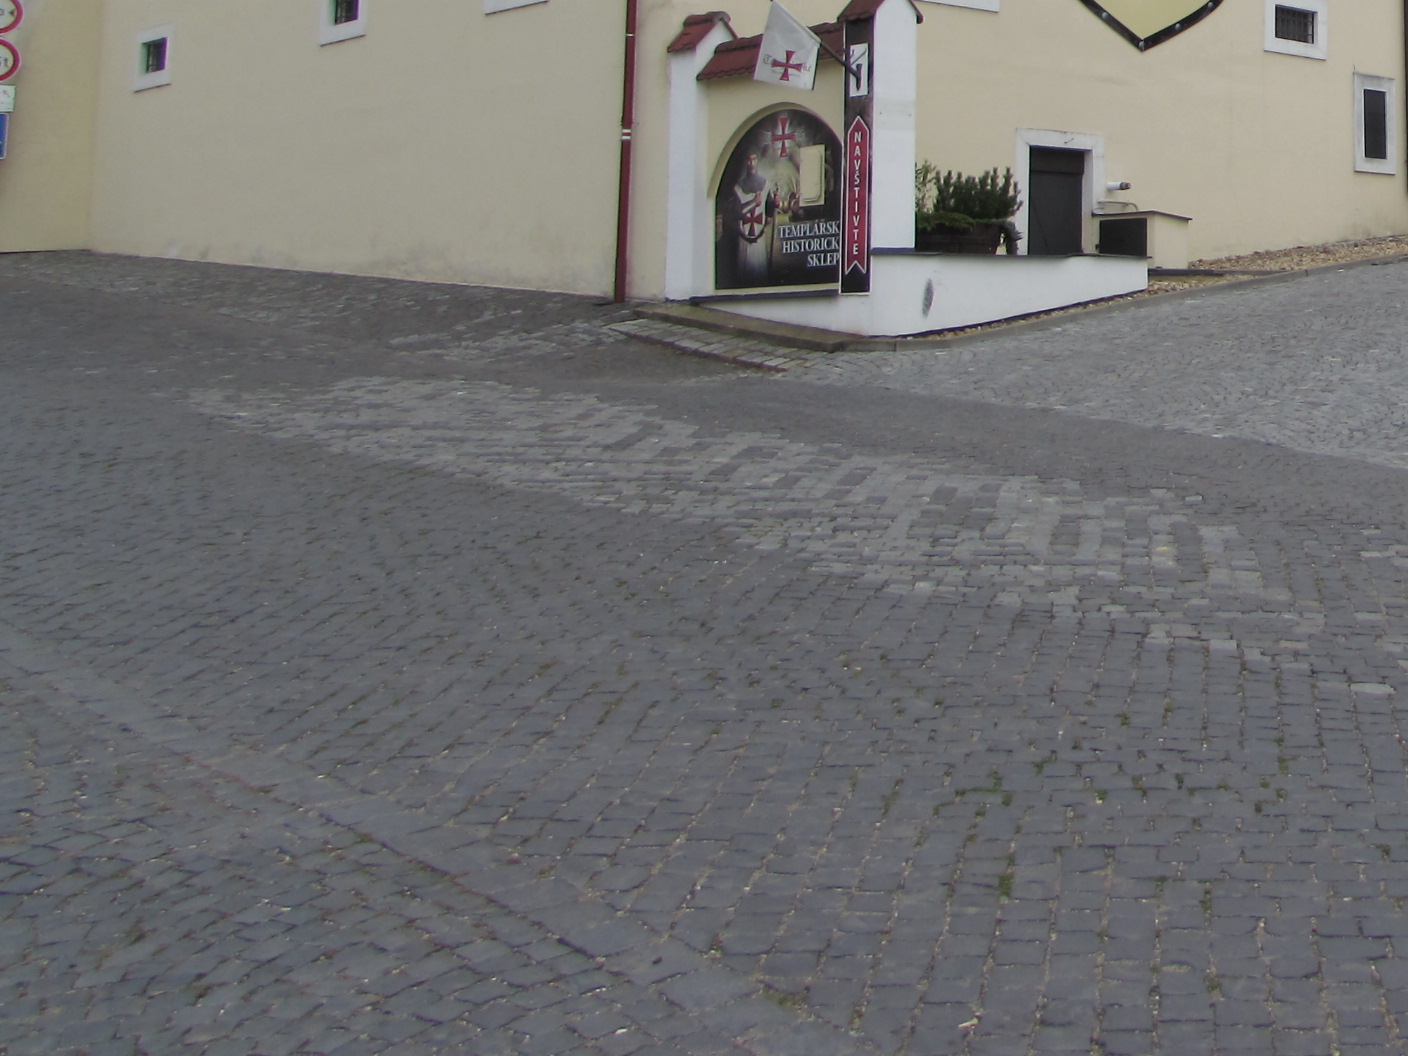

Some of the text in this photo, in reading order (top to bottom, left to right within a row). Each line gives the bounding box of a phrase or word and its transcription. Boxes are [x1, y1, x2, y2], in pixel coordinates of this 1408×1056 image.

[852, 131, 862, 255] NAVŠTIVTE
[779, 218, 840, 238] TEMPLÁŘSK
[782, 236, 840, 254] HISTORICK
[807, 252, 840, 267] SKLEP
